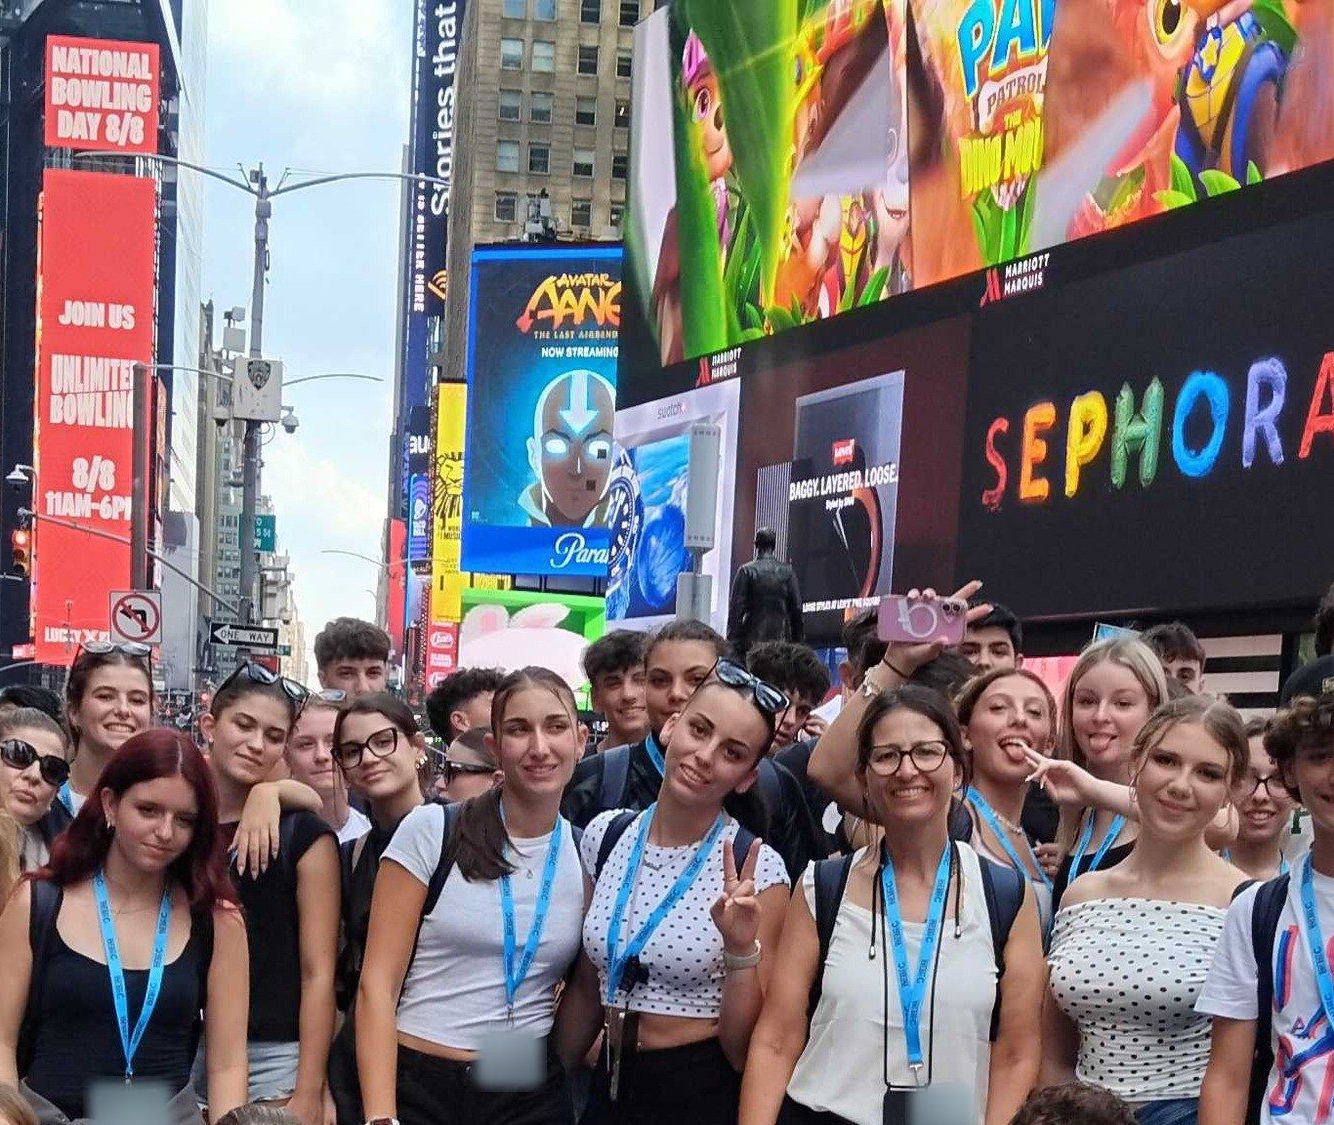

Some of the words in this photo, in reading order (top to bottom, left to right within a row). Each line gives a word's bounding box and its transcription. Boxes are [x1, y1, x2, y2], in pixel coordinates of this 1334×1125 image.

[433, 2, 457, 78] that
[52, 45, 153, 80] NATIONAL
[51, 76, 152, 113] BOWLING
[57, 109, 103, 141] DAY
[105, 112, 144, 147] 8/8
[430, 83, 456, 217] Stories
[557, 273, 614, 287] AVATAR
[1005, 253, 1050, 279] MARRIOTT
[1003, 271, 1044, 296] MARQUIS
[58, 300, 105, 328] JOIN
[108, 303, 135, 330] US
[534, 330, 550, 339] THE
[554, 330, 575, 339] LAST
[541, 347, 564, 358] NOW
[566, 346, 619, 358] STREAMING
[51, 353, 136, 394] UNLIMITE
[410, 434, 430, 454] au
[72, 455, 115, 493] 8/8
[789, 477, 820, 502] BAGGY.
[820, 471, 863, 496] LAYERED.
[865, 463, 898, 488] LOOSE.
[221, 629, 238, 640] ONE
[249, 632, 270, 642] WAY
